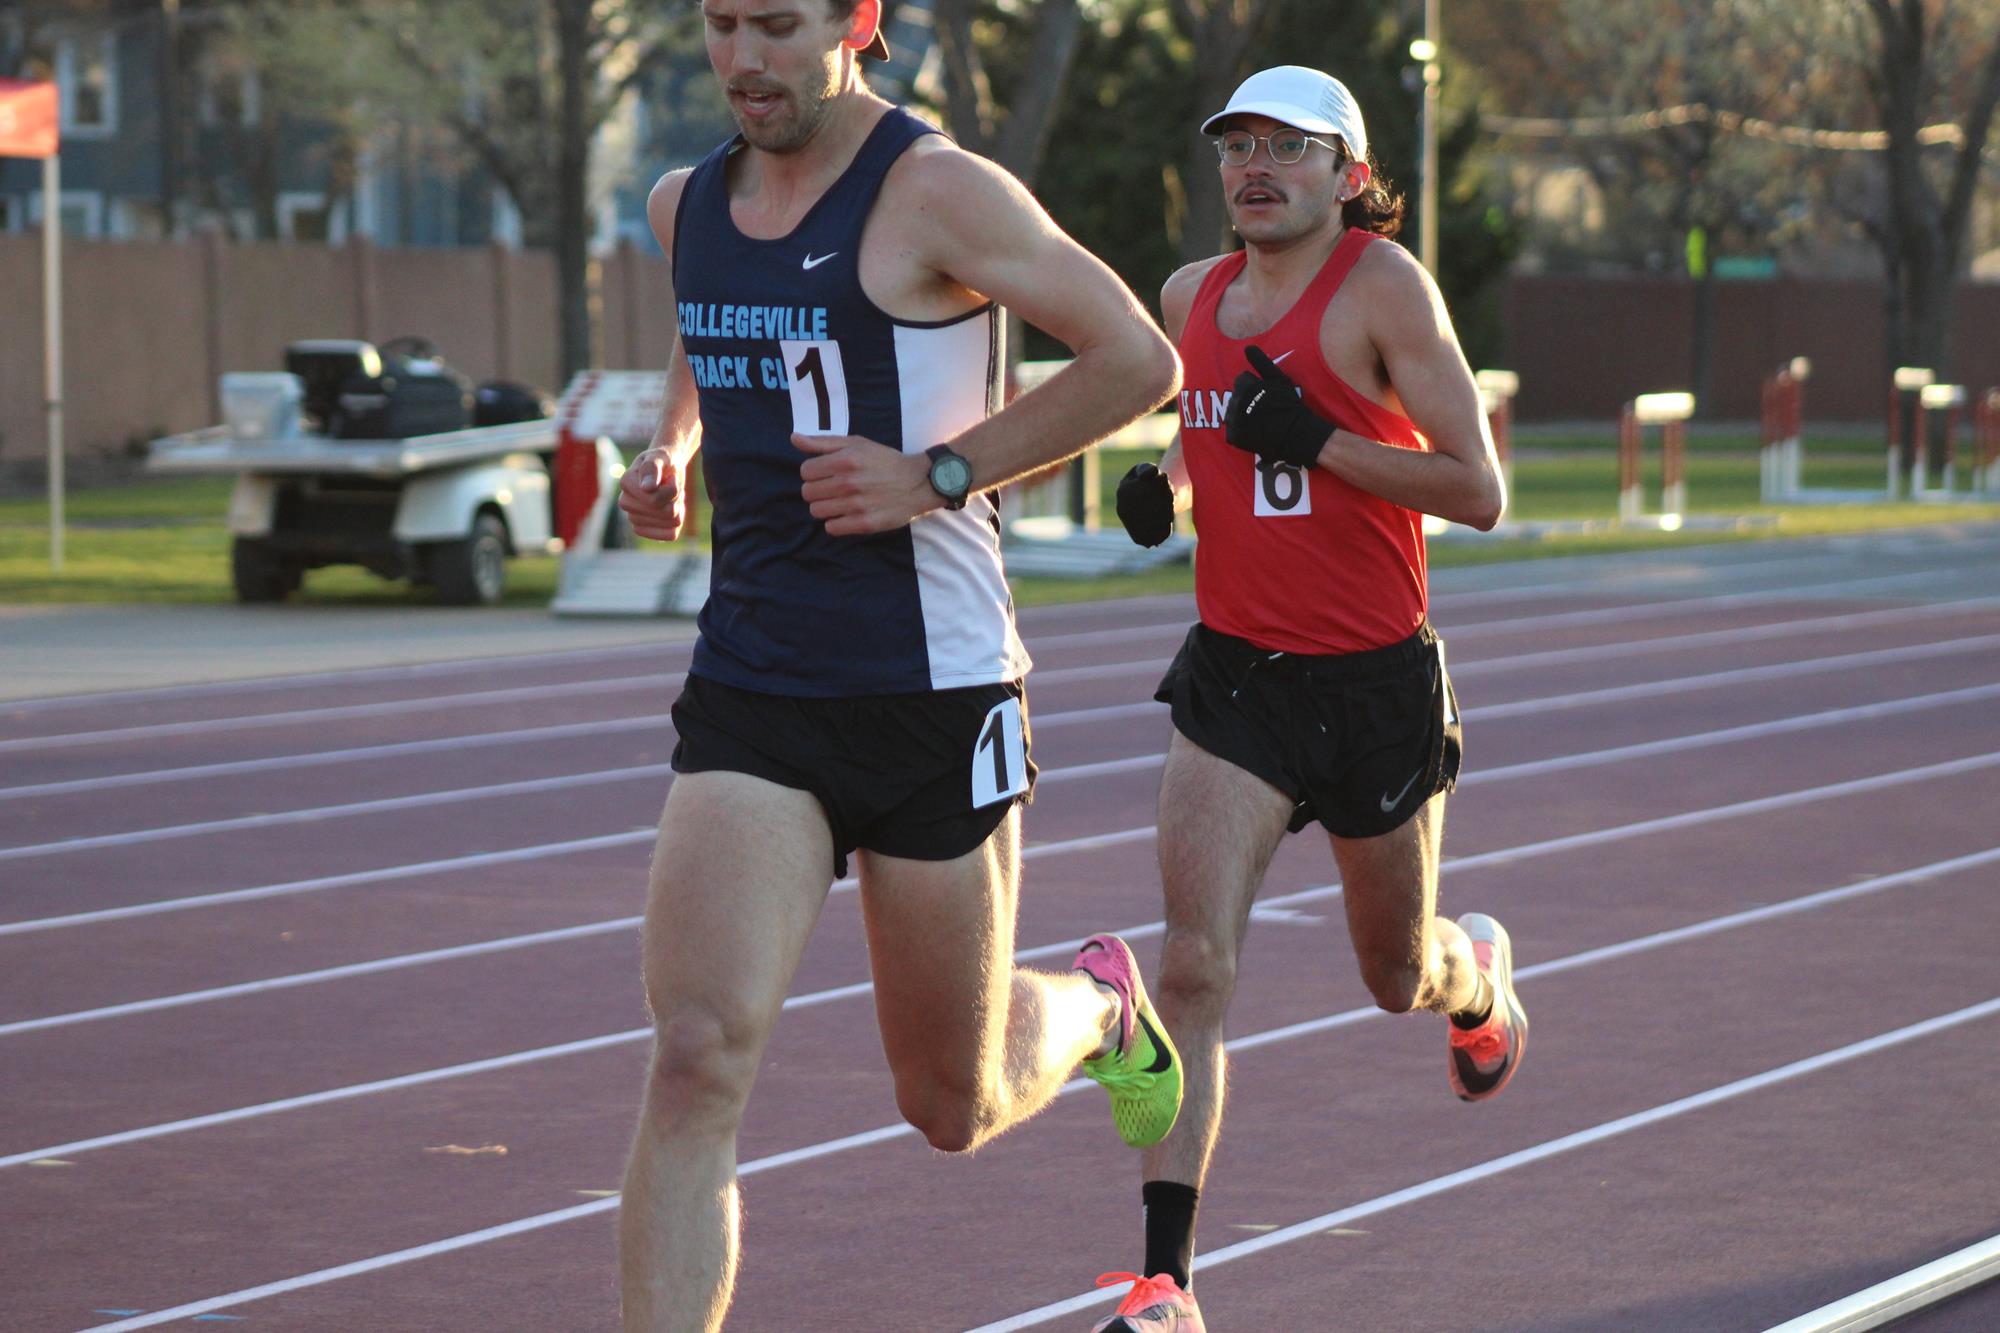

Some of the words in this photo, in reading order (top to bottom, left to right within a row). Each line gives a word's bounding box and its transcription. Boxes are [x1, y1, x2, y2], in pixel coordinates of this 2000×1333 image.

[678, 302, 827, 340] COLLEGEVILLE
[687, 356, 752, 388] TRACK
[760, 357, 789, 390] CL
[795, 347, 831, 430] 1
[1181, 390, 1233, 429] HAM
[1246, 389, 1266, 415] HEAD
[979, 709, 1009, 794] 1
